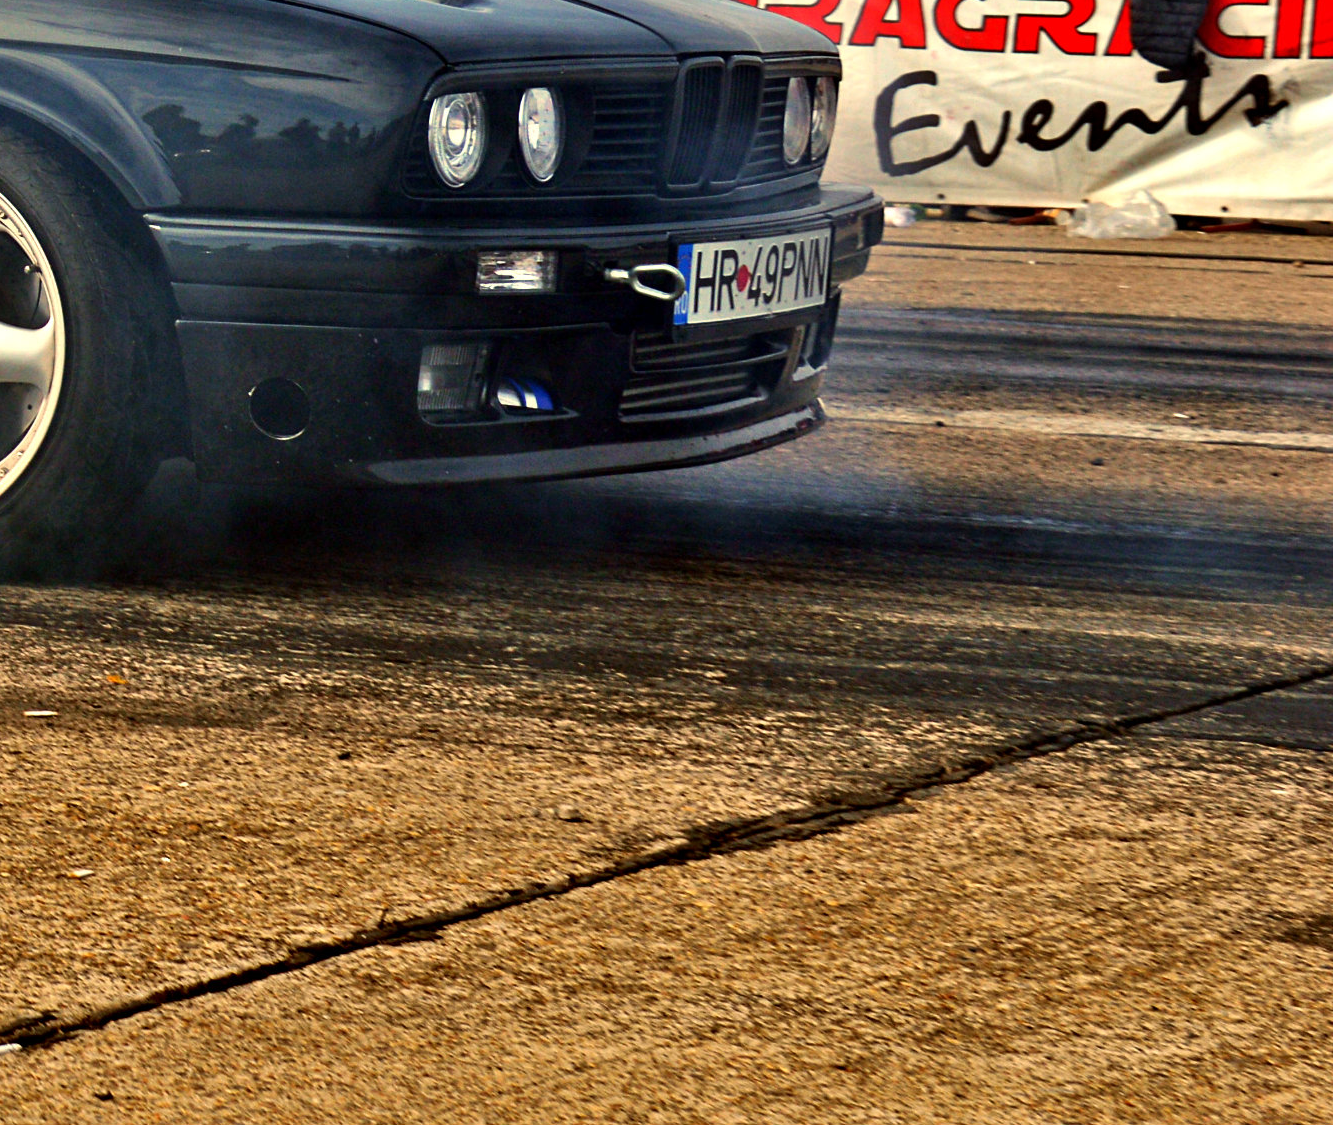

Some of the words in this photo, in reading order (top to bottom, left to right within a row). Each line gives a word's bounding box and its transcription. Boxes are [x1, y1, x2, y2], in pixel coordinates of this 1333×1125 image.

[874, 51, 1290, 177] Events
[694, 249, 739, 313] HR
[747, 236, 829, 307] 49PNN
